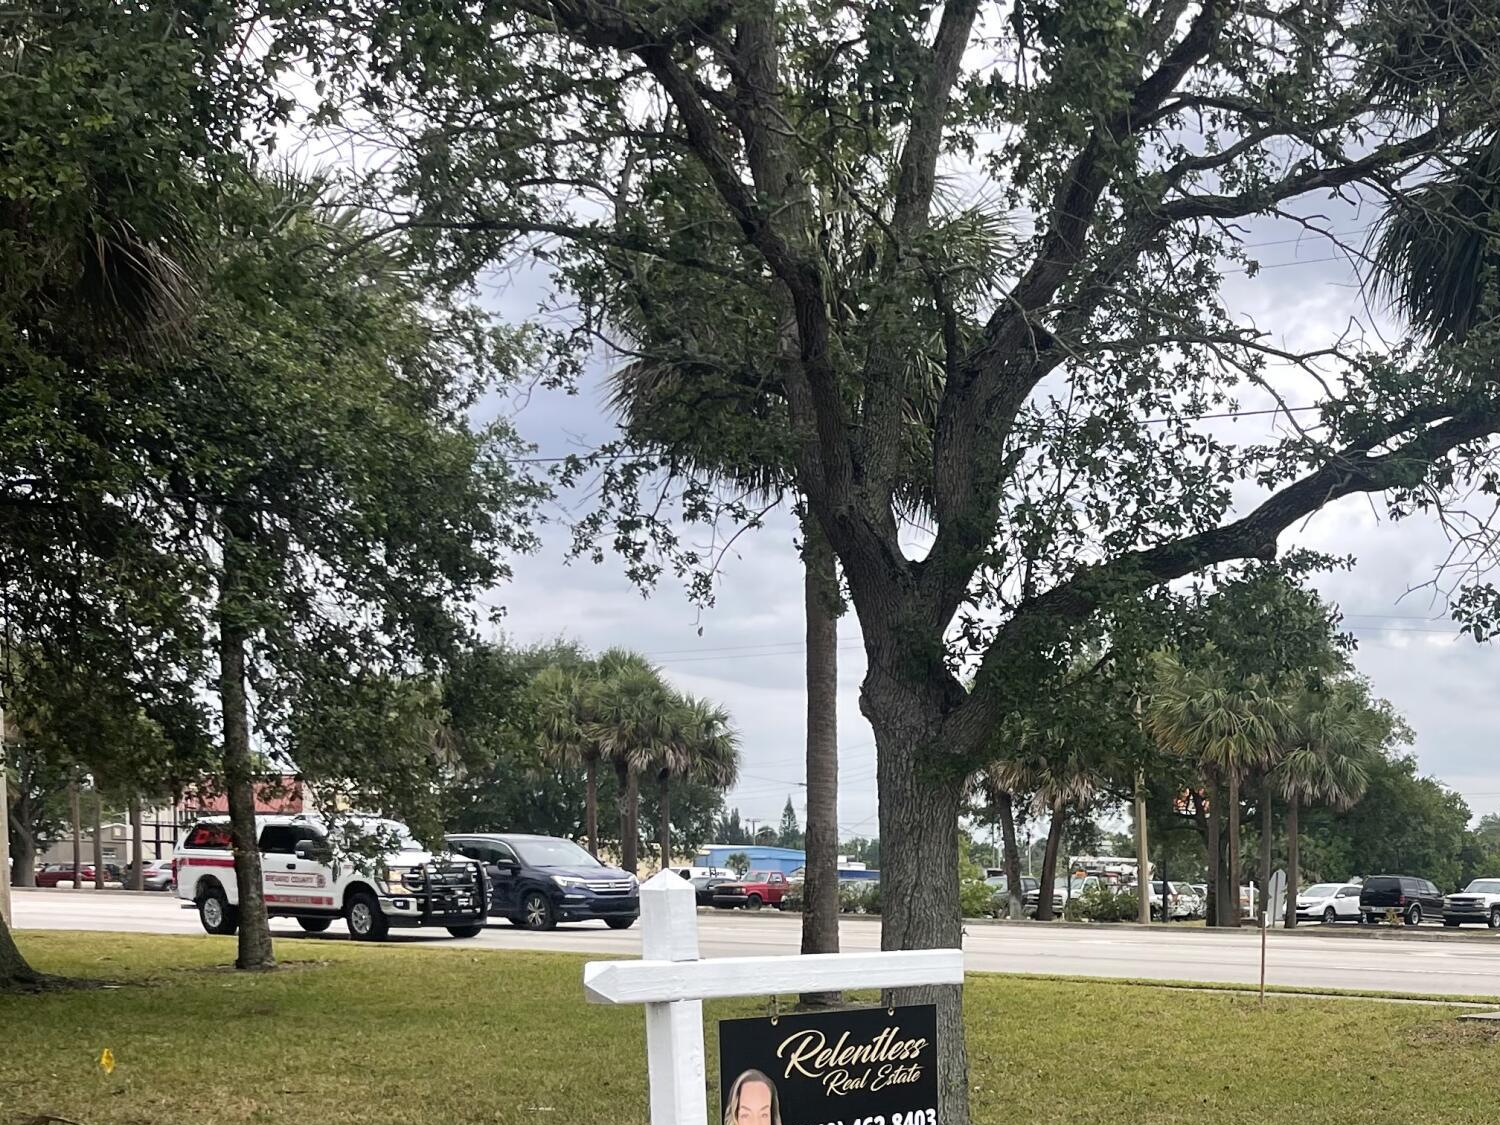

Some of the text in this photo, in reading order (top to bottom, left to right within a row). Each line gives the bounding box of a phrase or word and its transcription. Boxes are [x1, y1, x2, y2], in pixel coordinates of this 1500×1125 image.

[777, 1027, 929, 1078] Relentless
[823, 1064, 926, 1097] Real Estate
